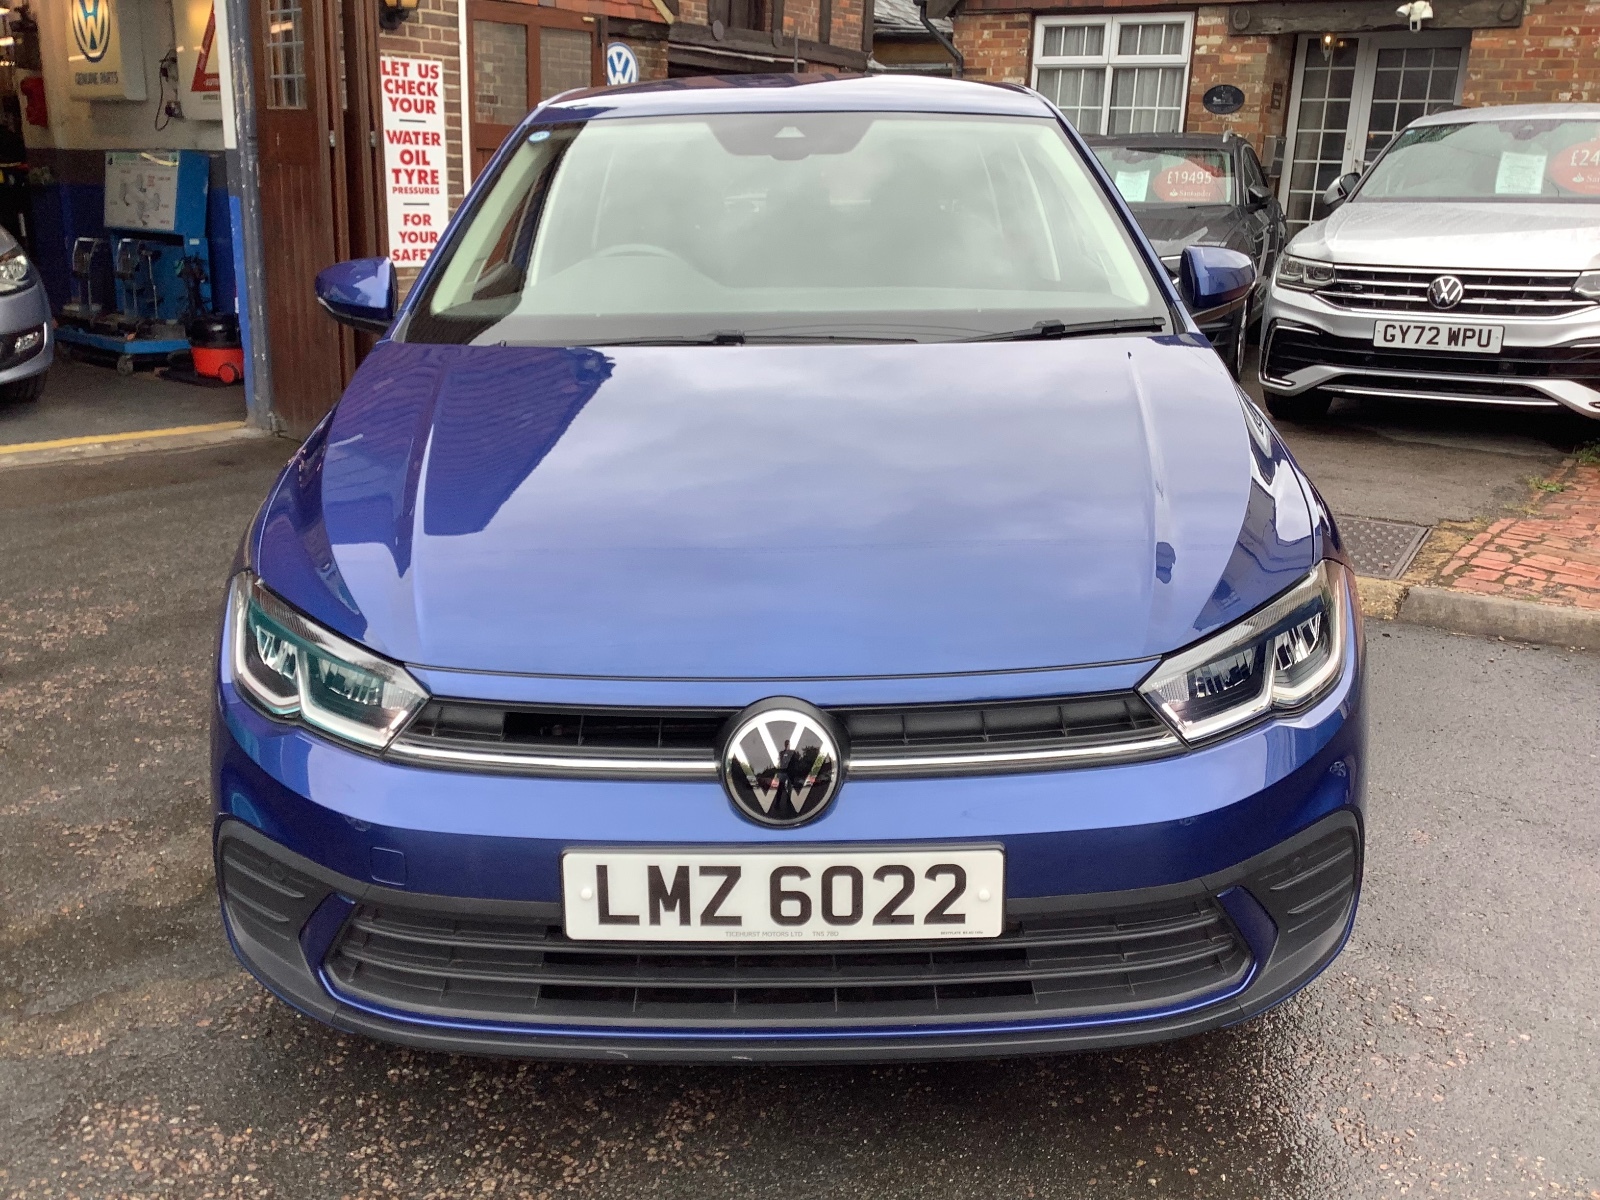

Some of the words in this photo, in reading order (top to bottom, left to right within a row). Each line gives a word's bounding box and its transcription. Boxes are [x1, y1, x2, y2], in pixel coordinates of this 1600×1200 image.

[381, 60, 410, 77] LET
[417, 63, 440, 80] US
[383, 78, 438, 97] CHECK
[388, 96, 437, 115] YOUR
[385, 129, 442, 147] WATER
[399, 148, 431, 166] OIL
[391, 168, 440, 186] TYRE
[1166, 170, 1212, 185] £19495
[392, 186, 440, 195] PRESSURES
[1179, 188, 1212, 197] Santander
[402, 213, 432, 226] FOR
[398, 230, 439, 244] YOUR
[1383, 324, 1441, 346] GY72
[1447, 326, 1492, 348] WPU
[595, 864, 743, 927] LMZ
[769, 863, 968, 927] 6022
[725, 930, 761, 938] TICEHURST
[762, 930, 790, 938] MOTORS
[790, 930, 803, 938] LTD
